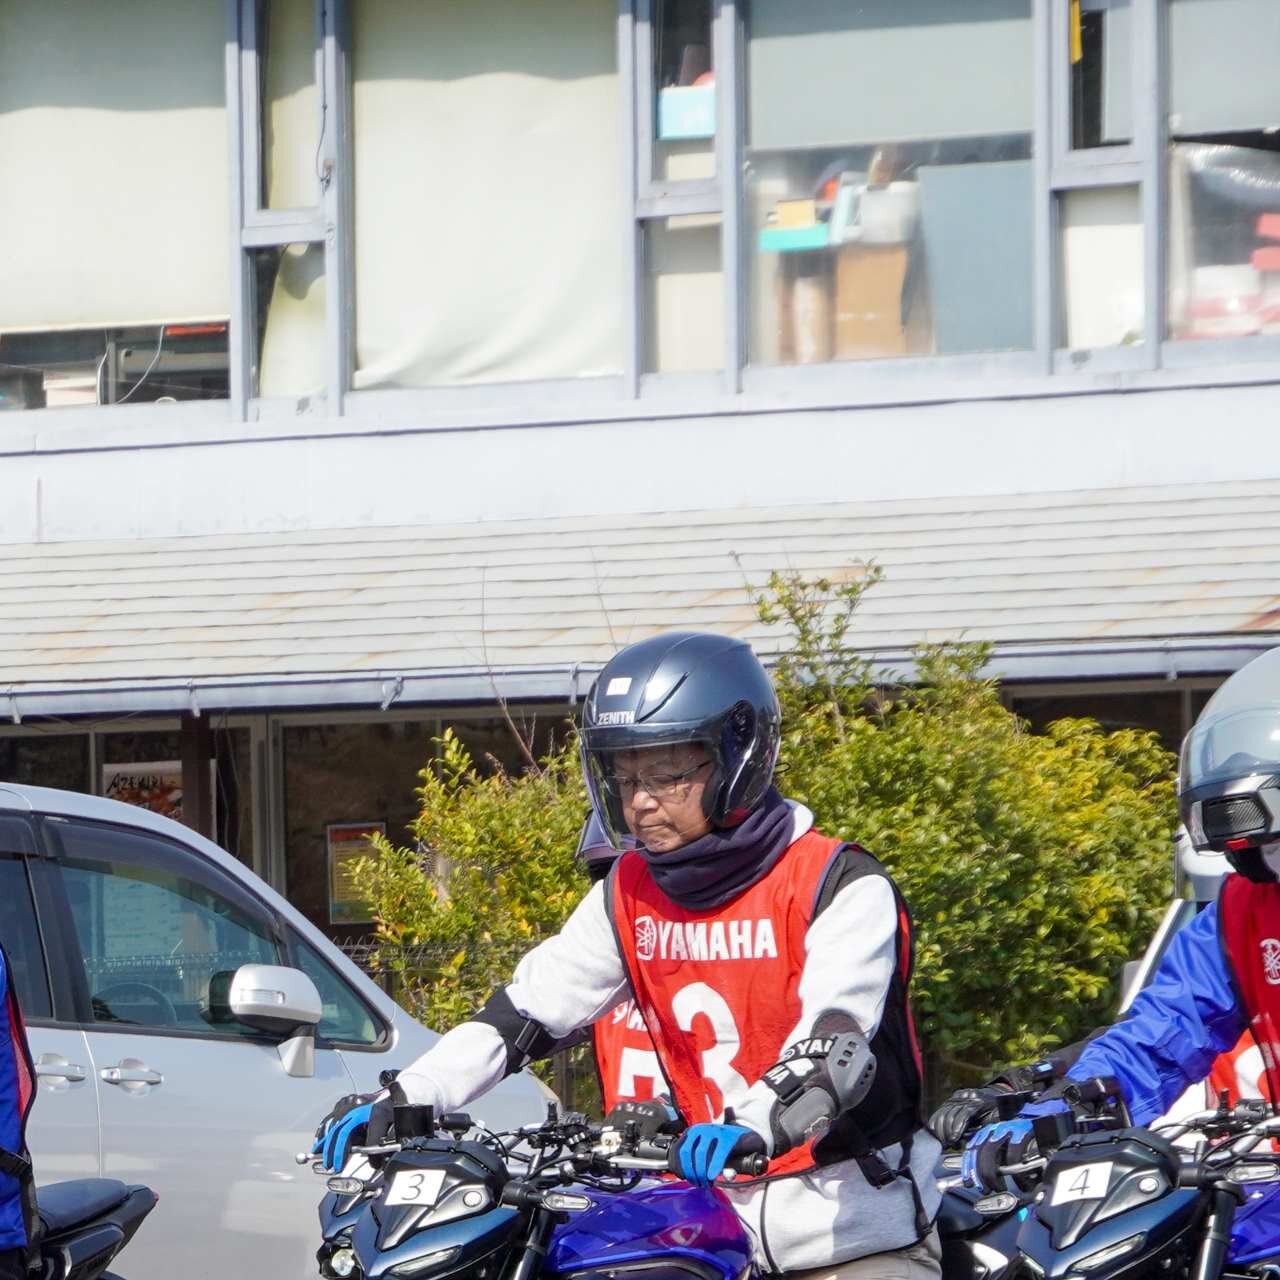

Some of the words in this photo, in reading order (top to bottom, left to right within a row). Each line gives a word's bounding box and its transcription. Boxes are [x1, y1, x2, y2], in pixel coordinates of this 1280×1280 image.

[597, 710, 635, 726] ZENITH
[658, 918, 778, 961] YAMAHA
[400, 1173, 425, 1201] 3
[1068, 1167, 1091, 1195] 4
